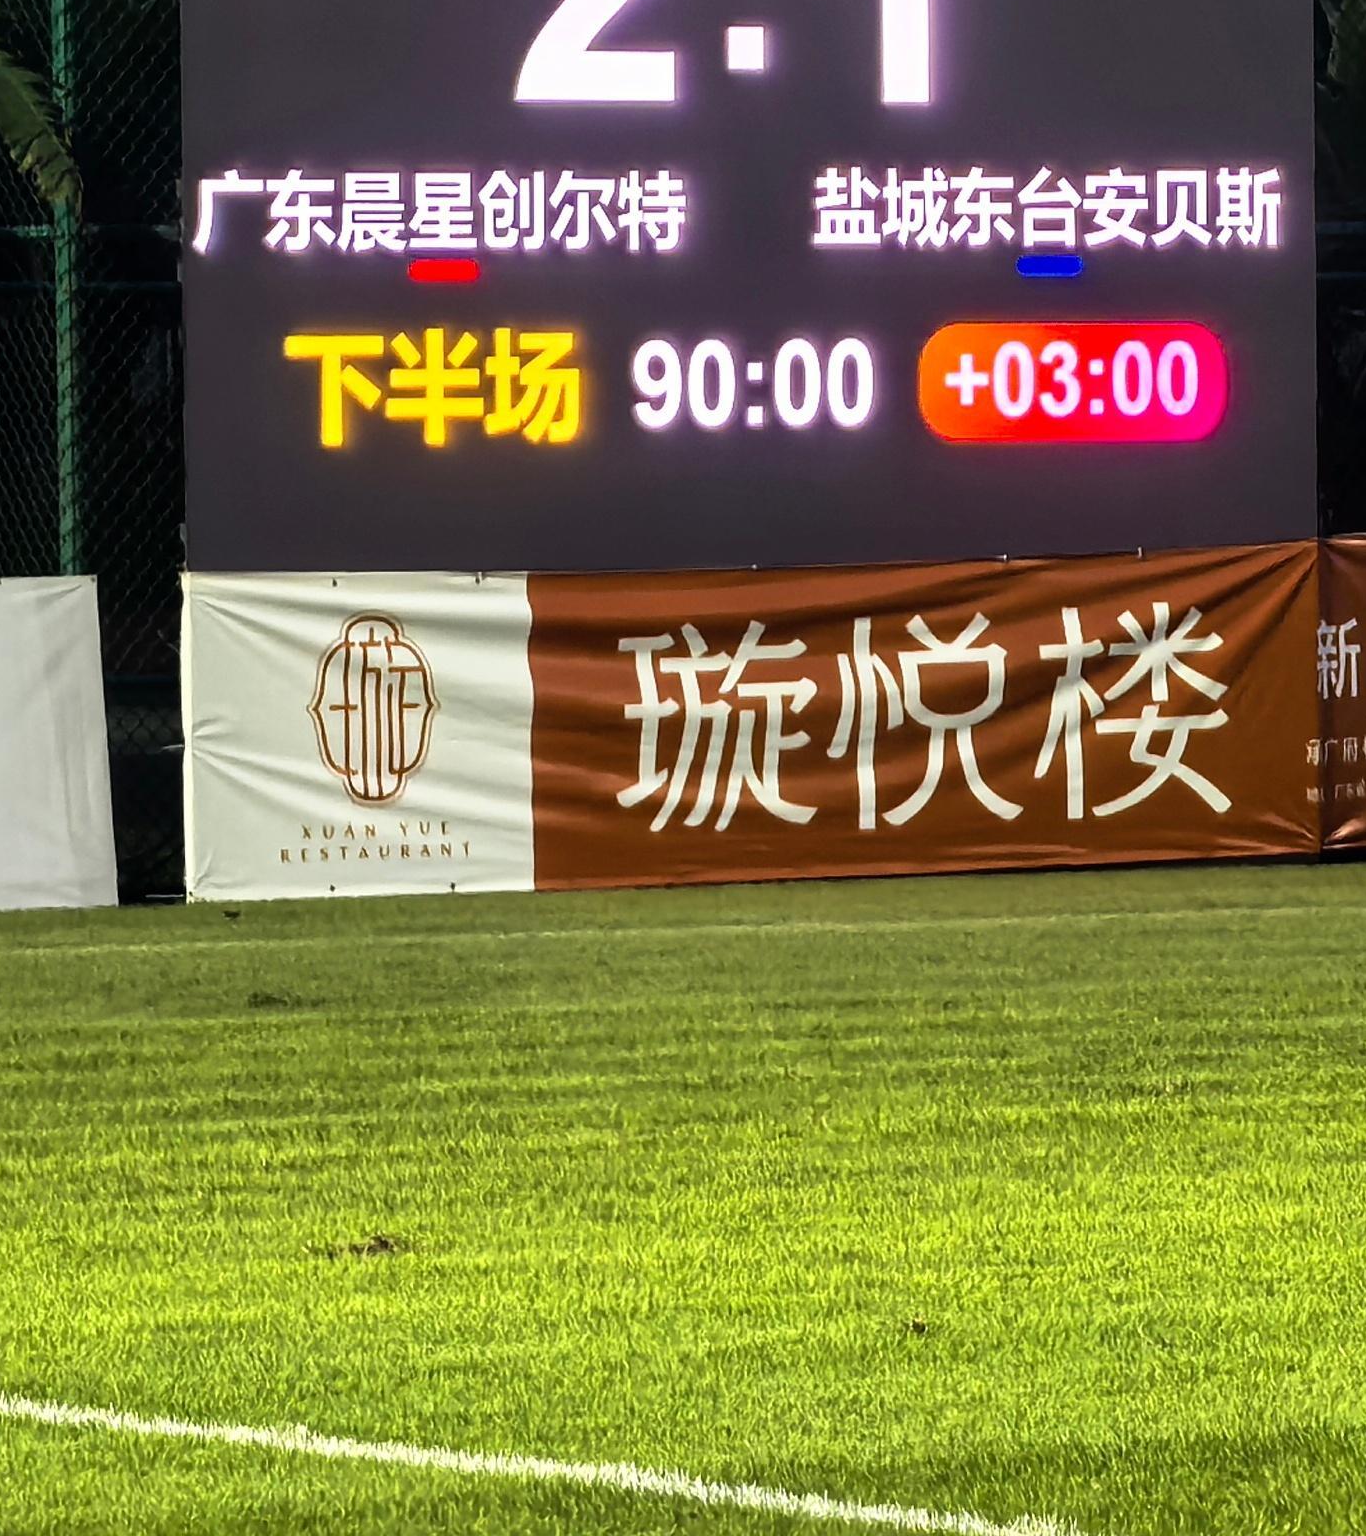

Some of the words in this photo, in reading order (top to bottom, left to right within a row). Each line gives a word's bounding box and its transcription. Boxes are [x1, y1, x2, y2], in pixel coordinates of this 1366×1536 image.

[191, 169, 688, 257] 广东晨星创尔特
[812, 166, 1283, 250] 盐城东台安贝斯
[283, 327, 582, 449] 下半场
[632, 338, 877, 431] 90:00
[942, 335, 1201, 421] +03:00
[616, 600, 1234, 833] 璇悦楼
[280, 841, 471, 864] RESTAURANT
[300, 821, 377, 841] XUAN
[399, 820, 451, 838] YUE
